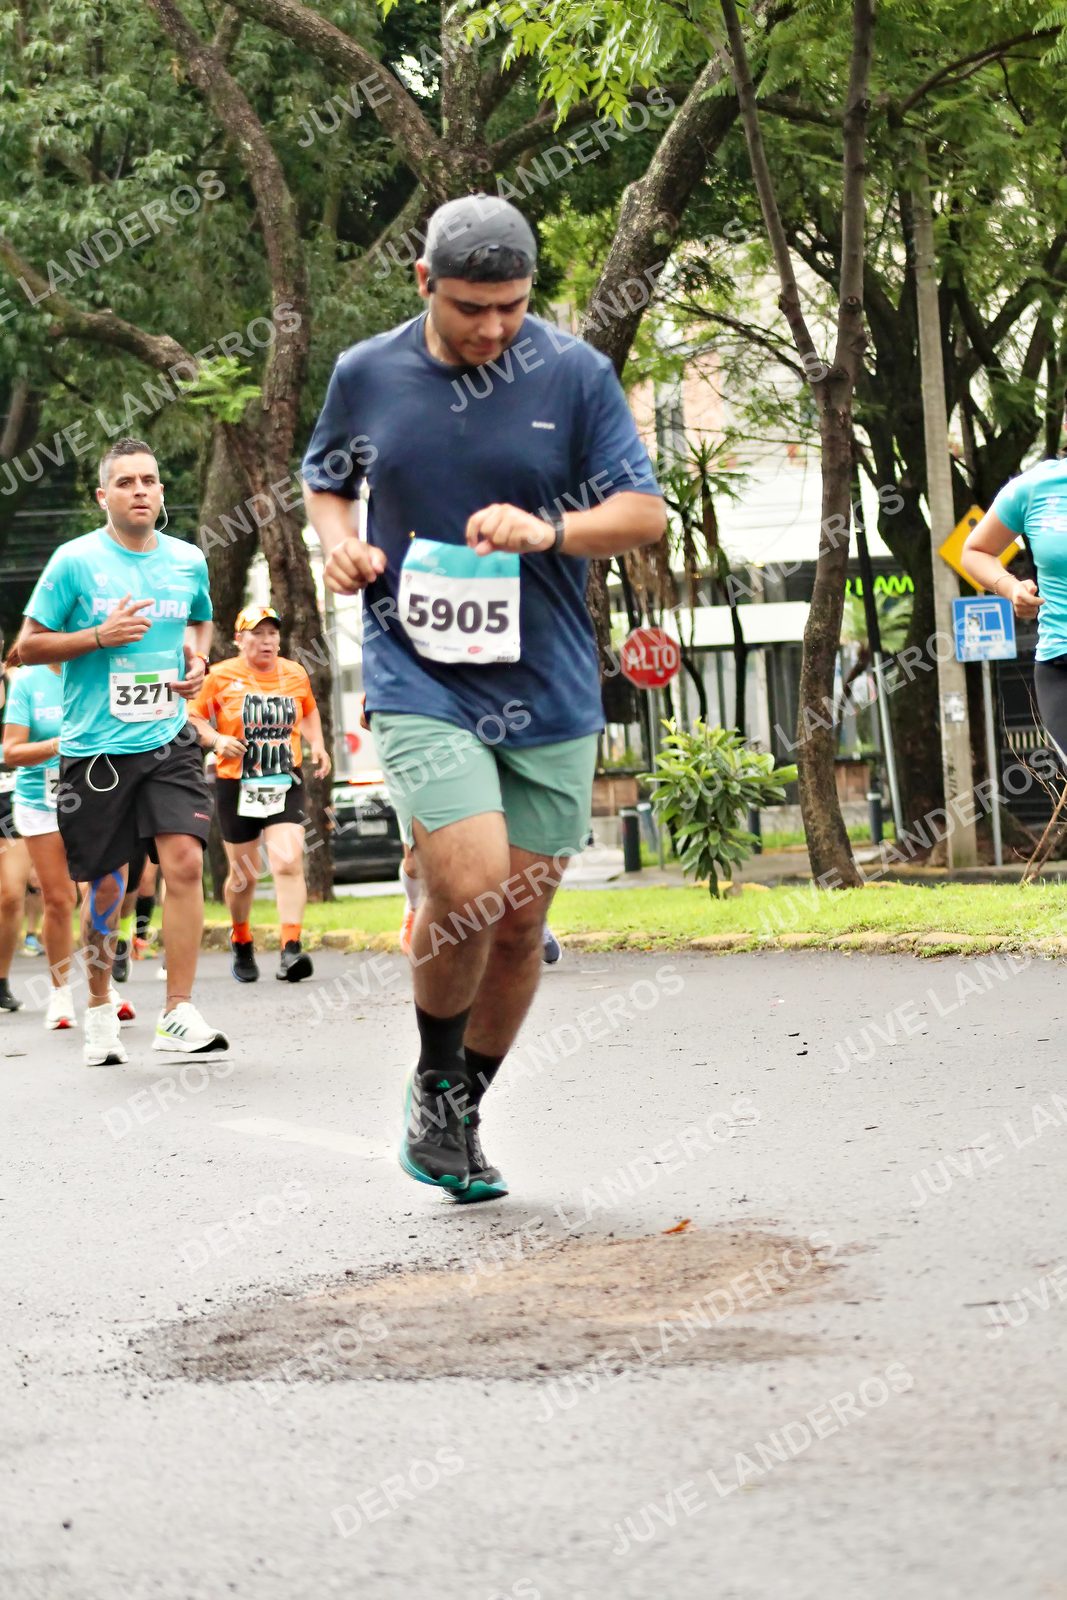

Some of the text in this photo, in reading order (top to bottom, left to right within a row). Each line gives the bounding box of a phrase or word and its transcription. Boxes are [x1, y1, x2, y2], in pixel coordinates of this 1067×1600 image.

[92, 597, 190, 620] PEURA
[407, 593, 509, 634] 5905
[627, 645, 676, 671] ALTO
[116, 682, 173, 706] 3271
